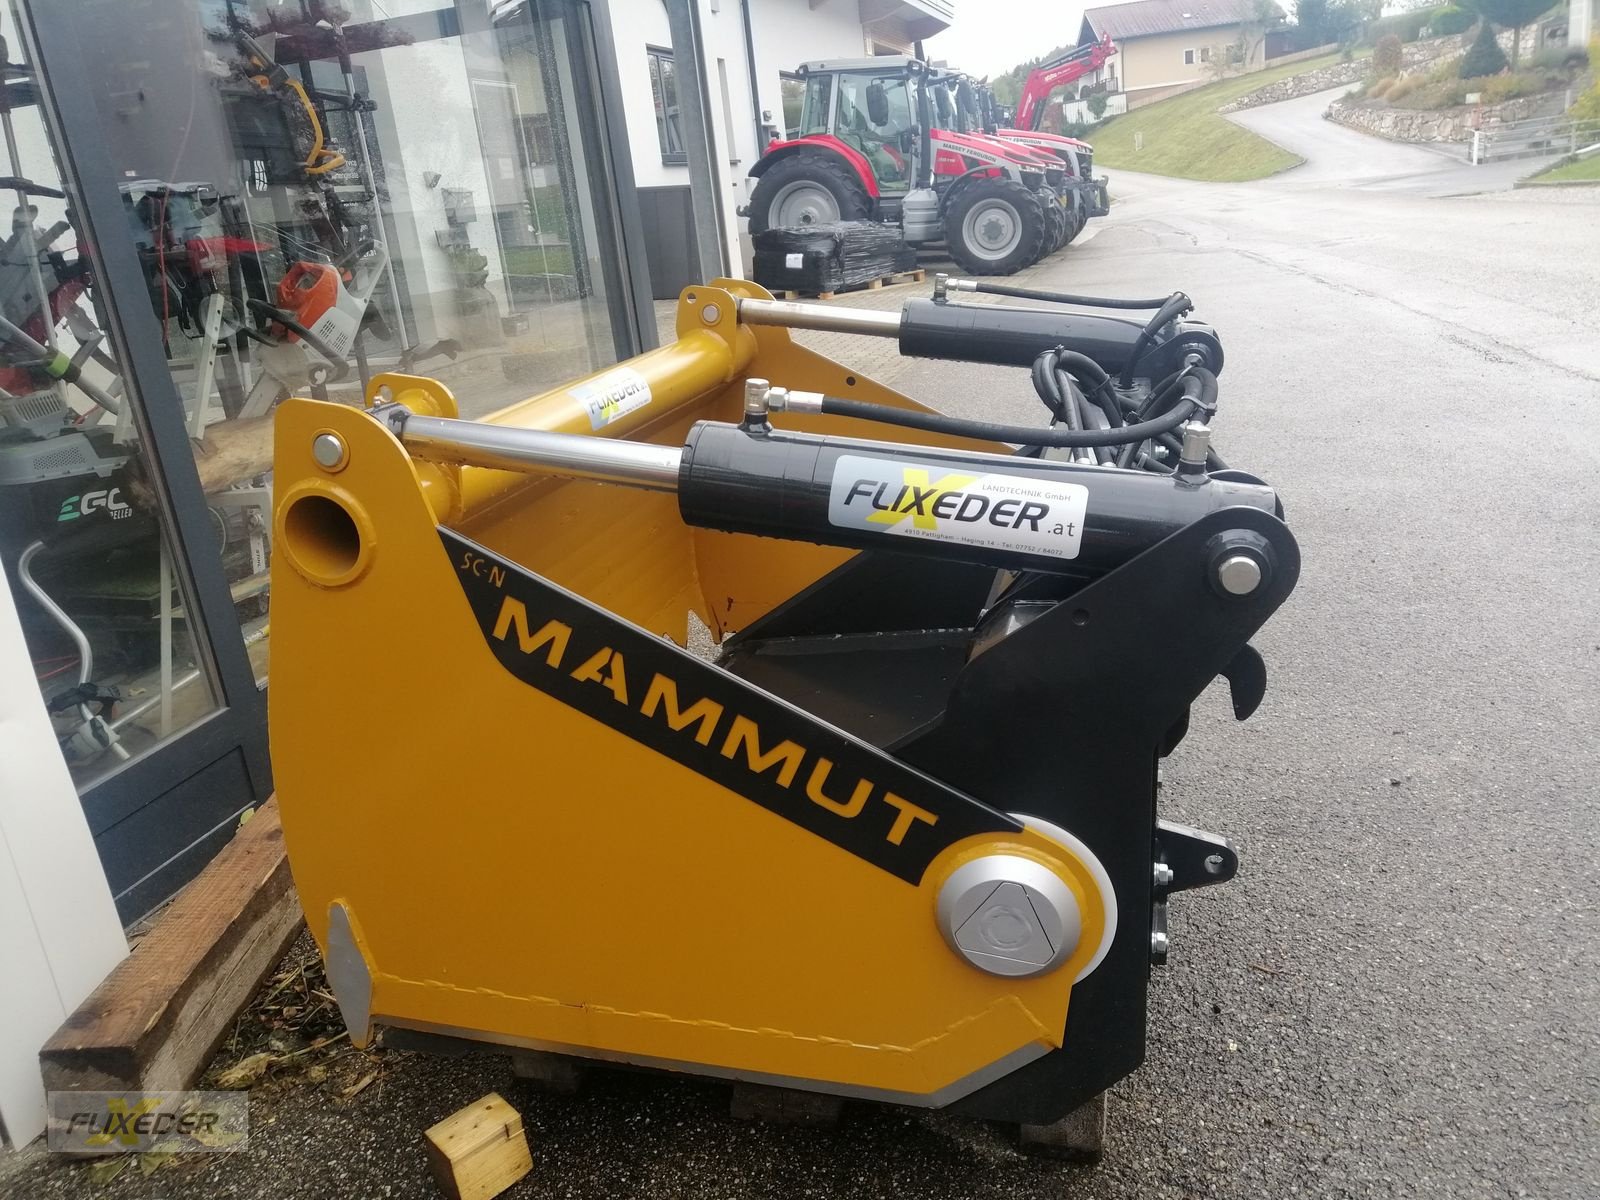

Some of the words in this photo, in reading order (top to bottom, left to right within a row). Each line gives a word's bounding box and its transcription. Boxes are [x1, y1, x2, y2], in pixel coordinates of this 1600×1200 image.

[943, 143, 966, 153] MASSEY
[967, 149, 997, 163] FERGUSON
[982, 484, 1042, 498] LANDTECHNIK
[1044, 492, 1072, 502] GmbH
[904, 528, 920, 536] 4910
[921, 530, 955, 541] Pattigham
[961, 536, 985, 546] Haging
[1015, 543, 1036, 552] 07752
[461, 552, 506, 588] SC-N
[493, 595, 939, 847] MAMMUT
